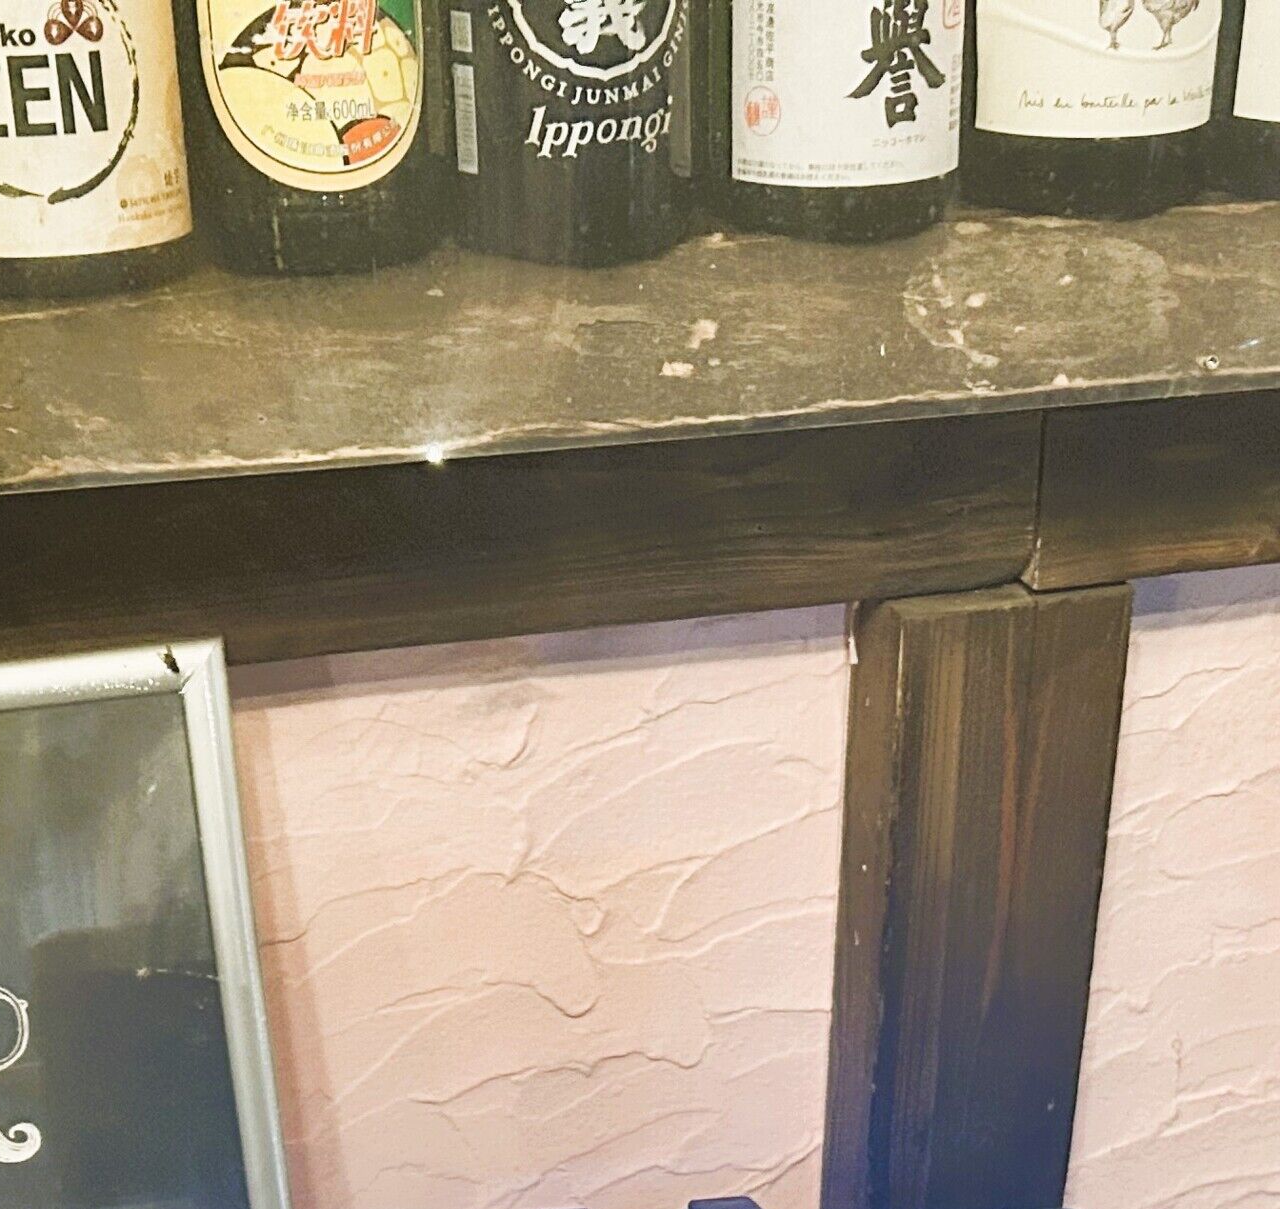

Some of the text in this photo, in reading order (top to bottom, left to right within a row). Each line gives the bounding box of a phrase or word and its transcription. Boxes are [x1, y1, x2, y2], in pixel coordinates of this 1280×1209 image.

[487, 5, 569, 98] IPPONGI
[571, 65, 662, 106] JUNMAI
[524, 94, 673, 159] Ippongi
